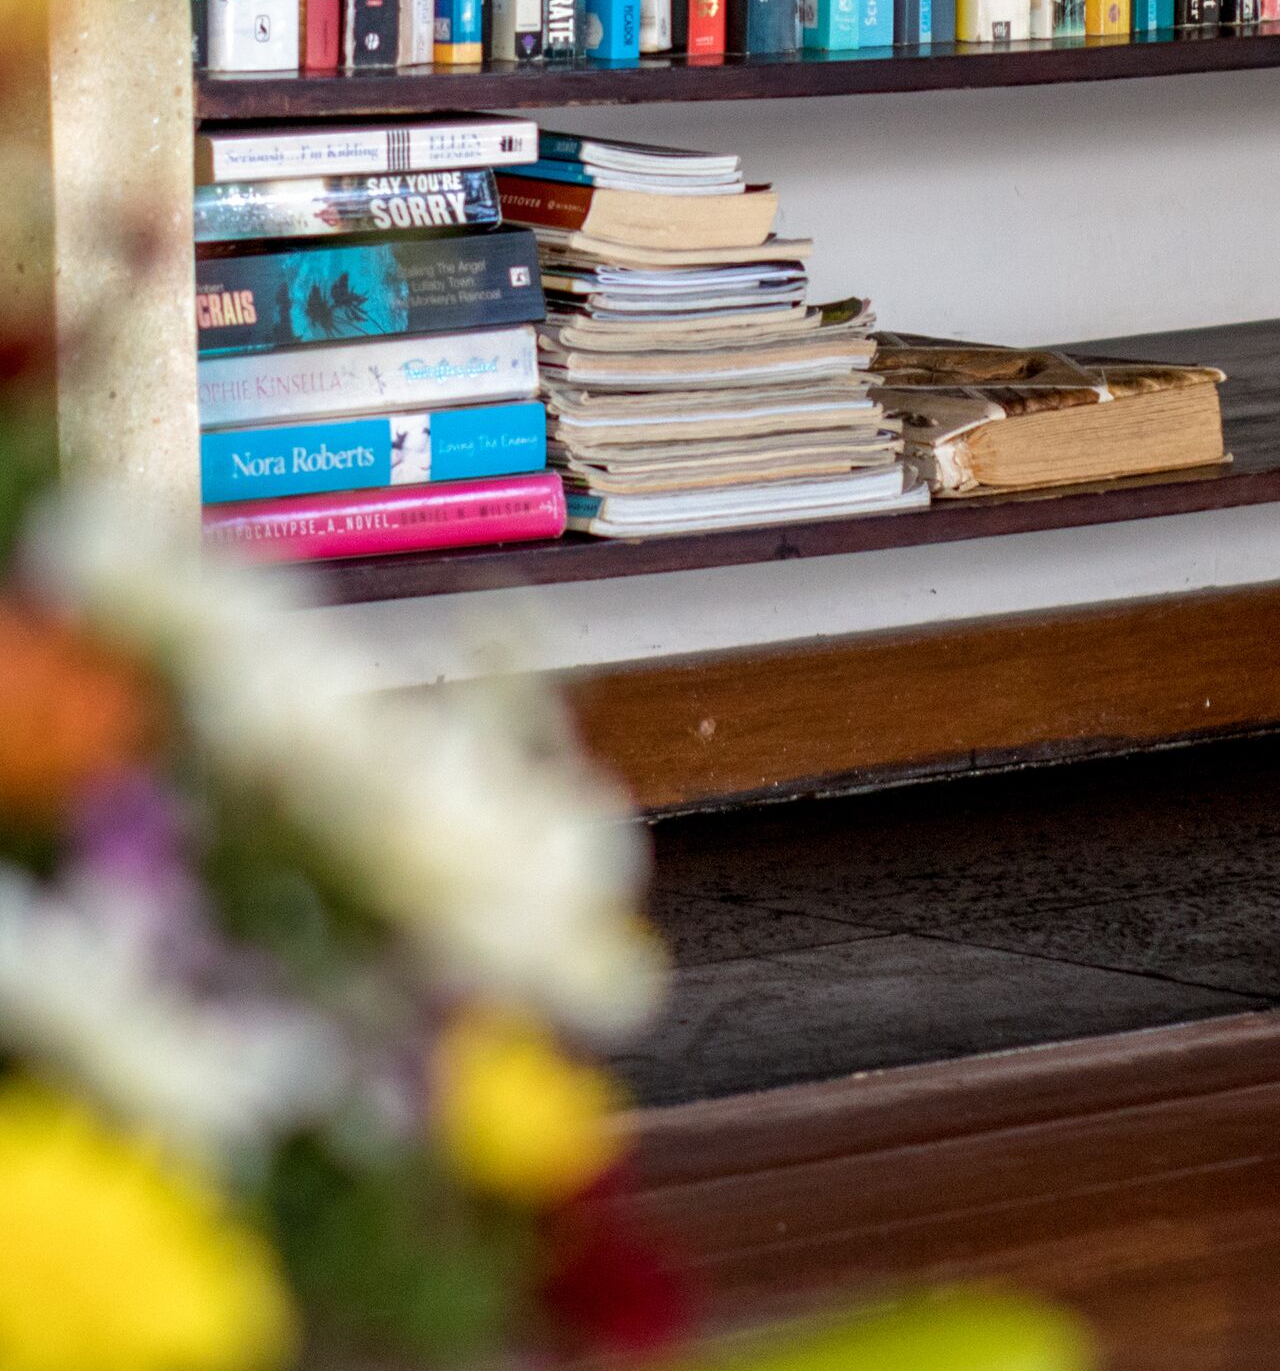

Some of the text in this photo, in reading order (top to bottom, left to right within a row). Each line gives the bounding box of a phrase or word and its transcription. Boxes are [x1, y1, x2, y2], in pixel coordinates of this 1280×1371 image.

[623, 4, 635, 47] PICADOR
[326, 144, 380, 162] Kidding
[428, 132, 483, 151] ELLEN
[366, 172, 462, 196] SAY YOU'RE
[370, 192, 468, 229] SORRY
[499, 194, 541, 209] ESTOVER
[458, 259, 486, 275] Angel
[197, 290, 258, 329] CRAIS
[255, 370, 342, 398] KINSELLA
[232, 442, 376, 479] Nora Roberts
[399, 507, 451, 526] DANIEL
[479, 499, 532, 518] WILSON
